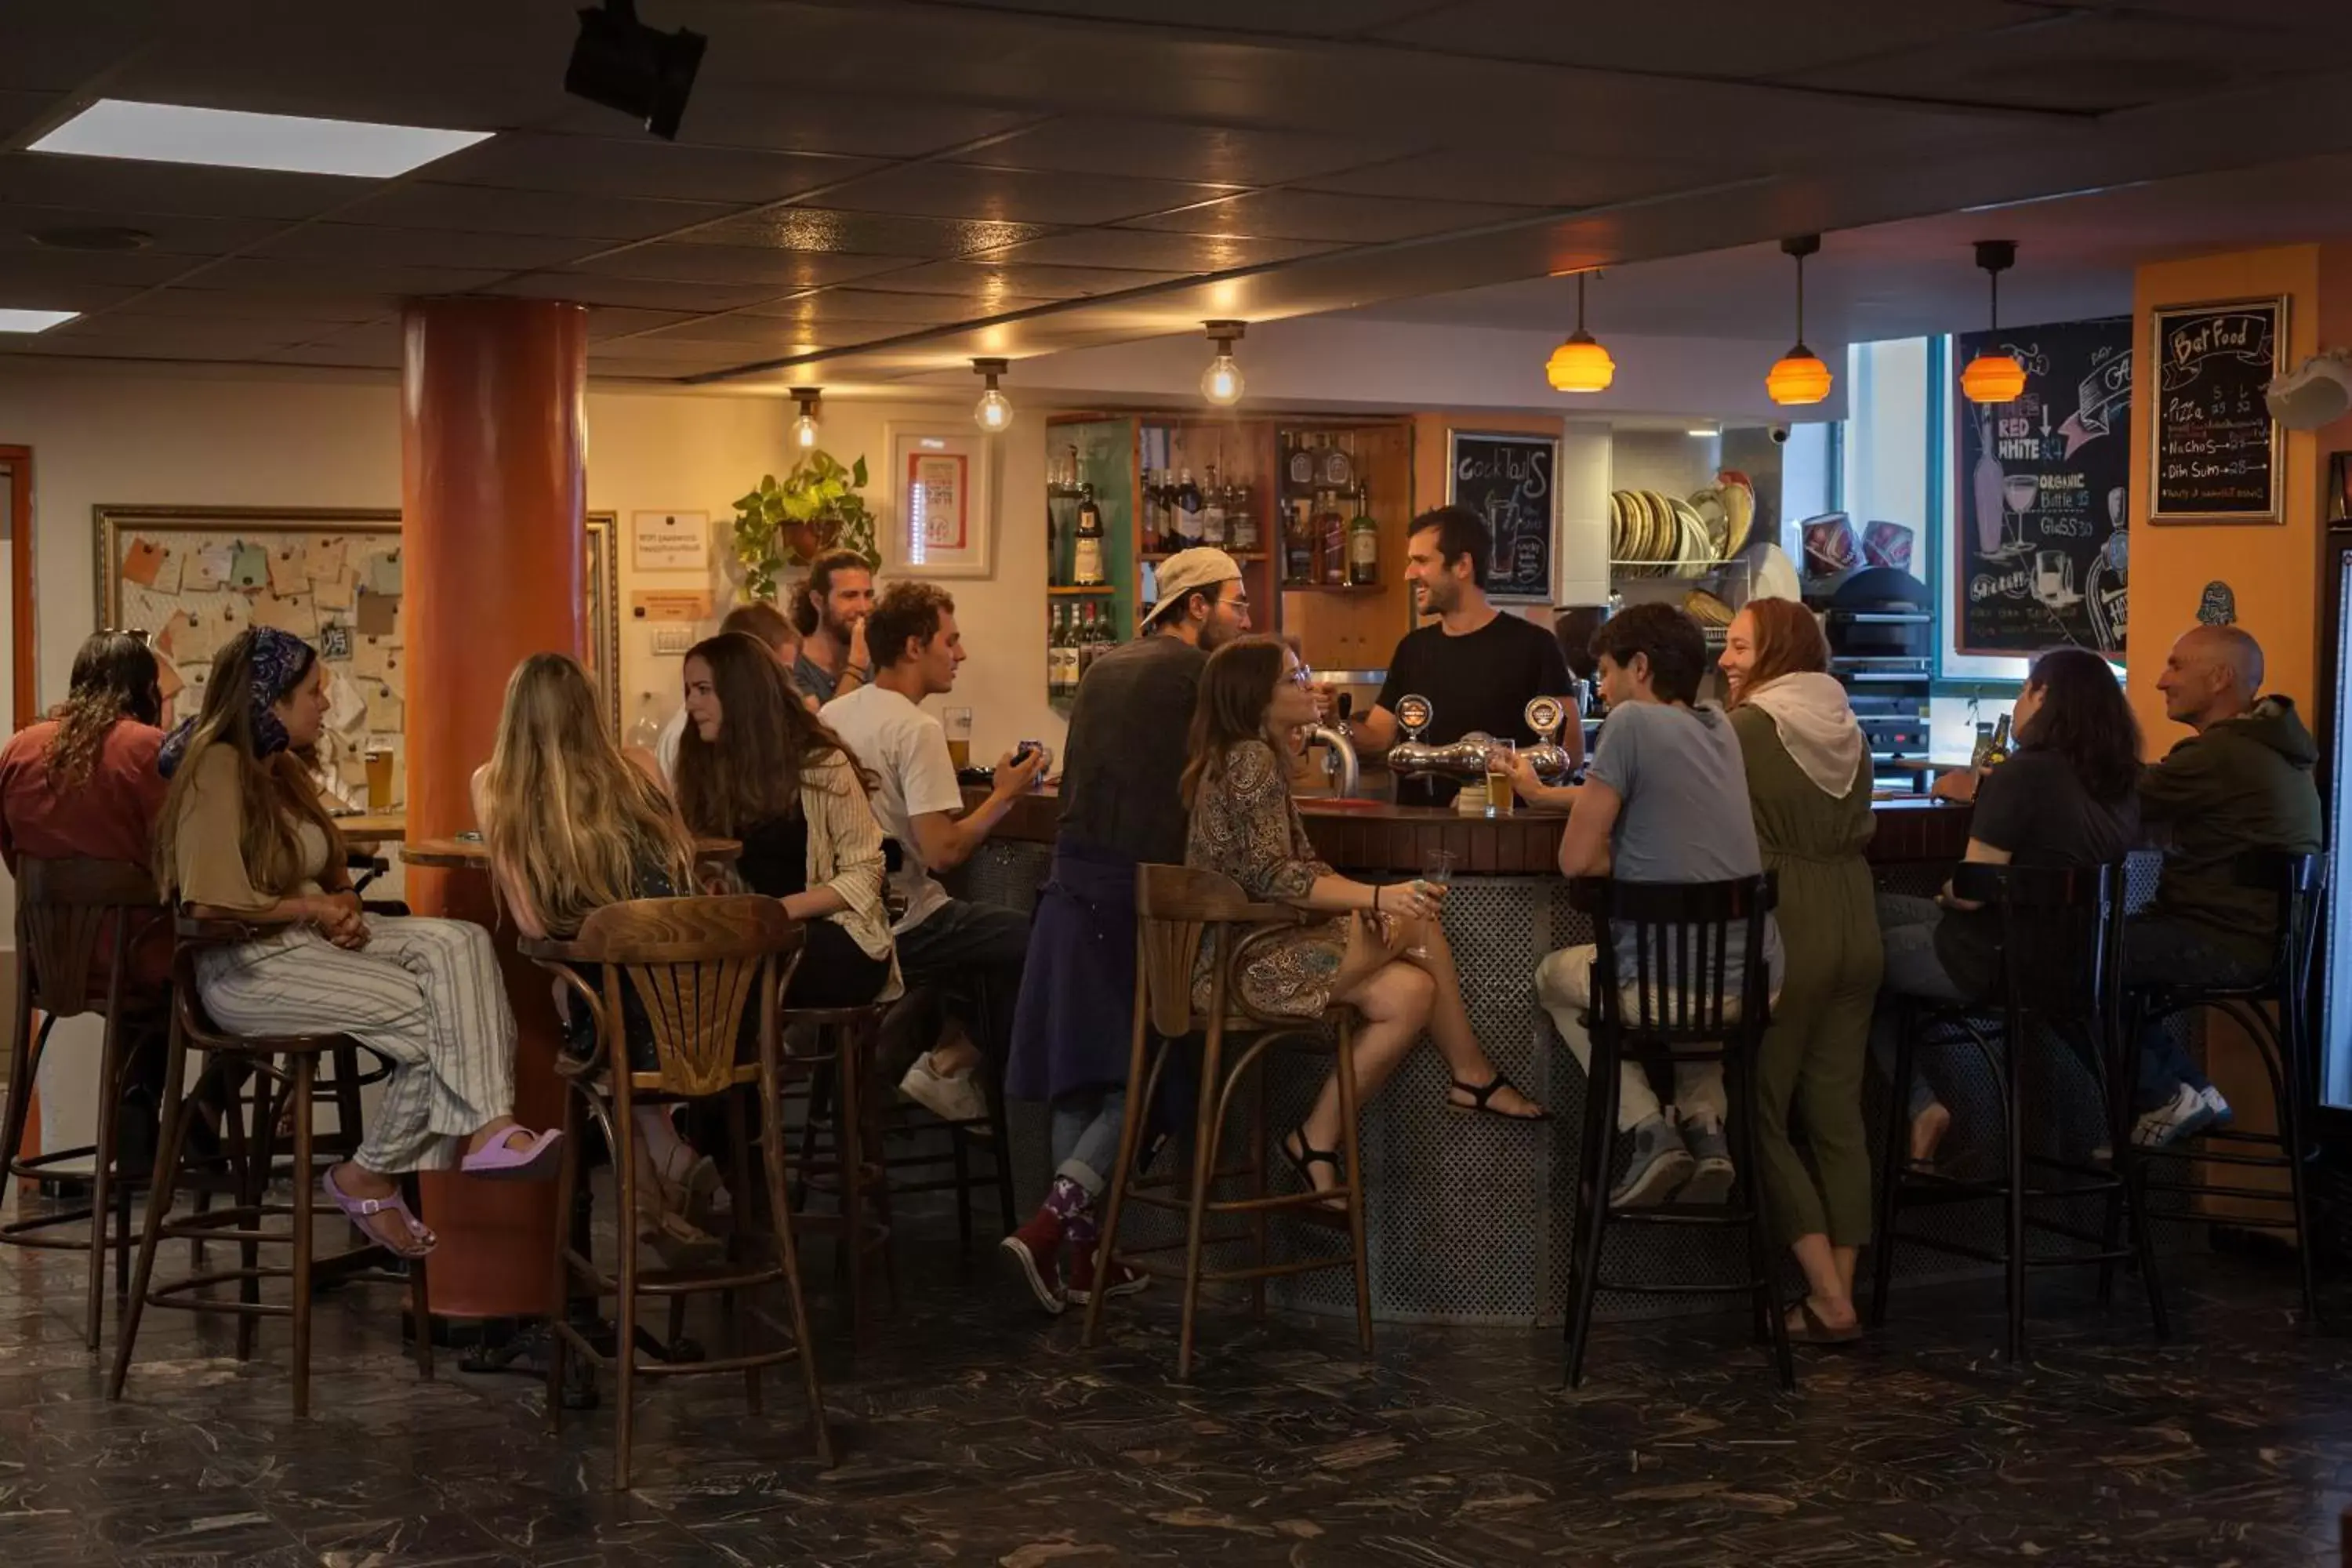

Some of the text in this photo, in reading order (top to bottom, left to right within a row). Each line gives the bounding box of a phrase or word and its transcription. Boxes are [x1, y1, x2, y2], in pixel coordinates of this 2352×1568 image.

[2212, 318, 2249, 348] Food
[1998, 417, 2030, 437] RED
[2190, 460, 2220, 478] Sum
[2039, 473, 2085, 489] ORGANIC
